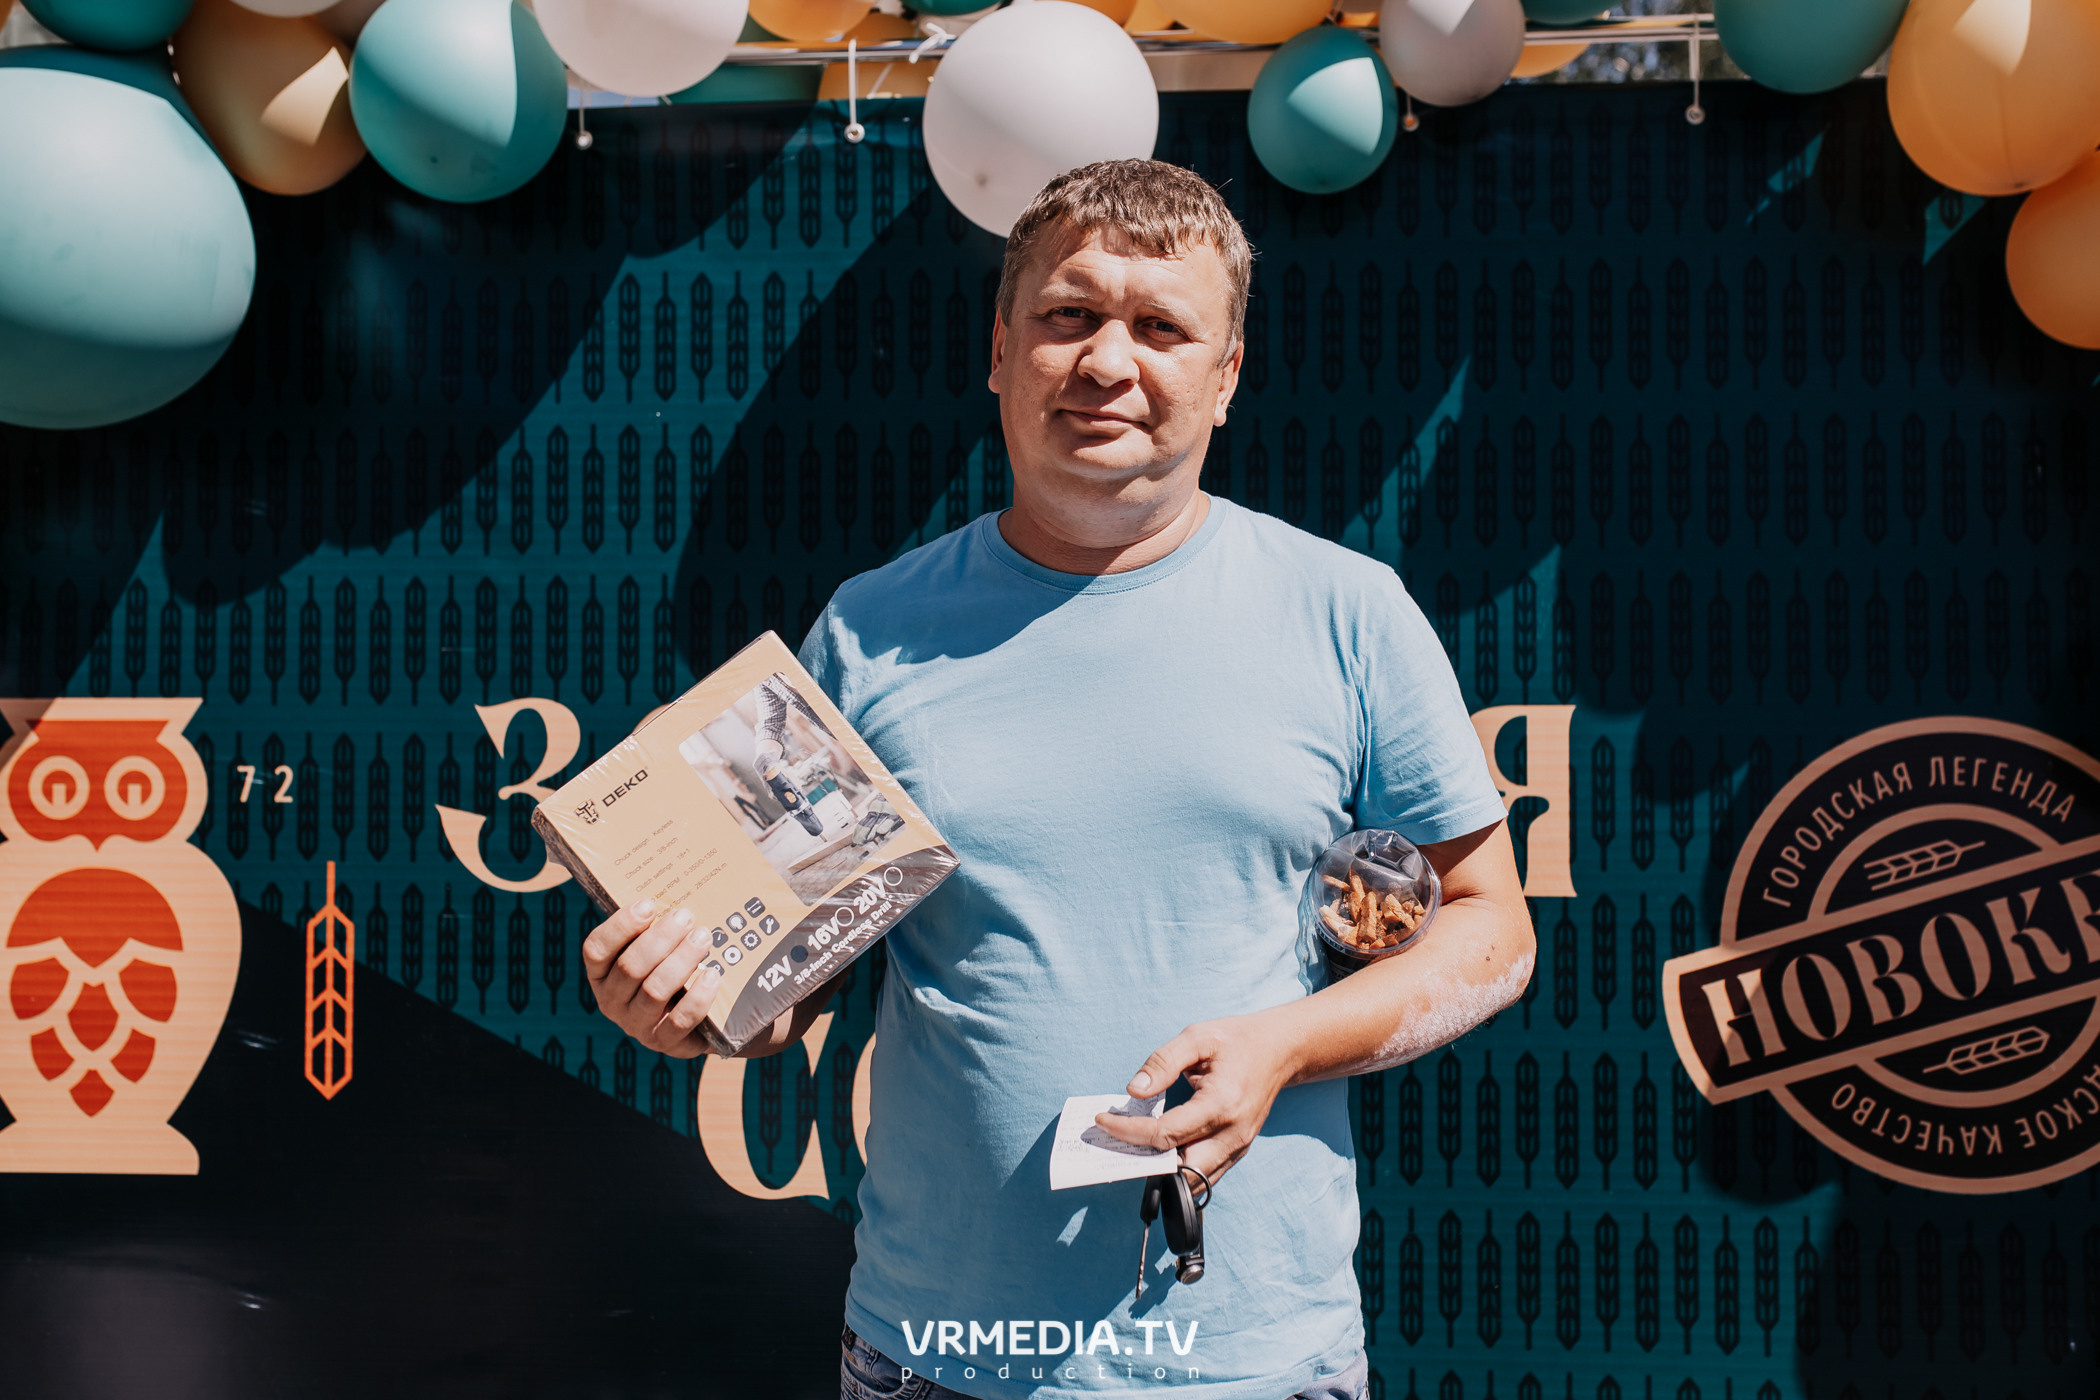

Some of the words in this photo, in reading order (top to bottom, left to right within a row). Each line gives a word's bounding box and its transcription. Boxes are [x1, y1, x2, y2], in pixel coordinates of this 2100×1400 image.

[236, 765, 295, 804] 72
[602, 769, 648, 807] DEKO
[614, 852, 632, 866] Chuck
[652, 820, 674, 836] Keyless
[1762, 761, 1913, 908] ГОРОДСКАЯ
[1927, 755, 2075, 823] ЛЕГЕНДА
[625, 865, 642, 880] Chuck
[635, 878, 653, 893] Clutch
[757, 955, 793, 993] 12V
[807, 916, 841, 951] 16V
[853, 879, 888, 915] 20V
[793, 951, 833, 985] 3/8-Inch
[831, 918, 873, 954] Cordless
[870, 899, 893, 921] Drill
[1830, 1082, 2004, 1157] КАЧЕСТВО
